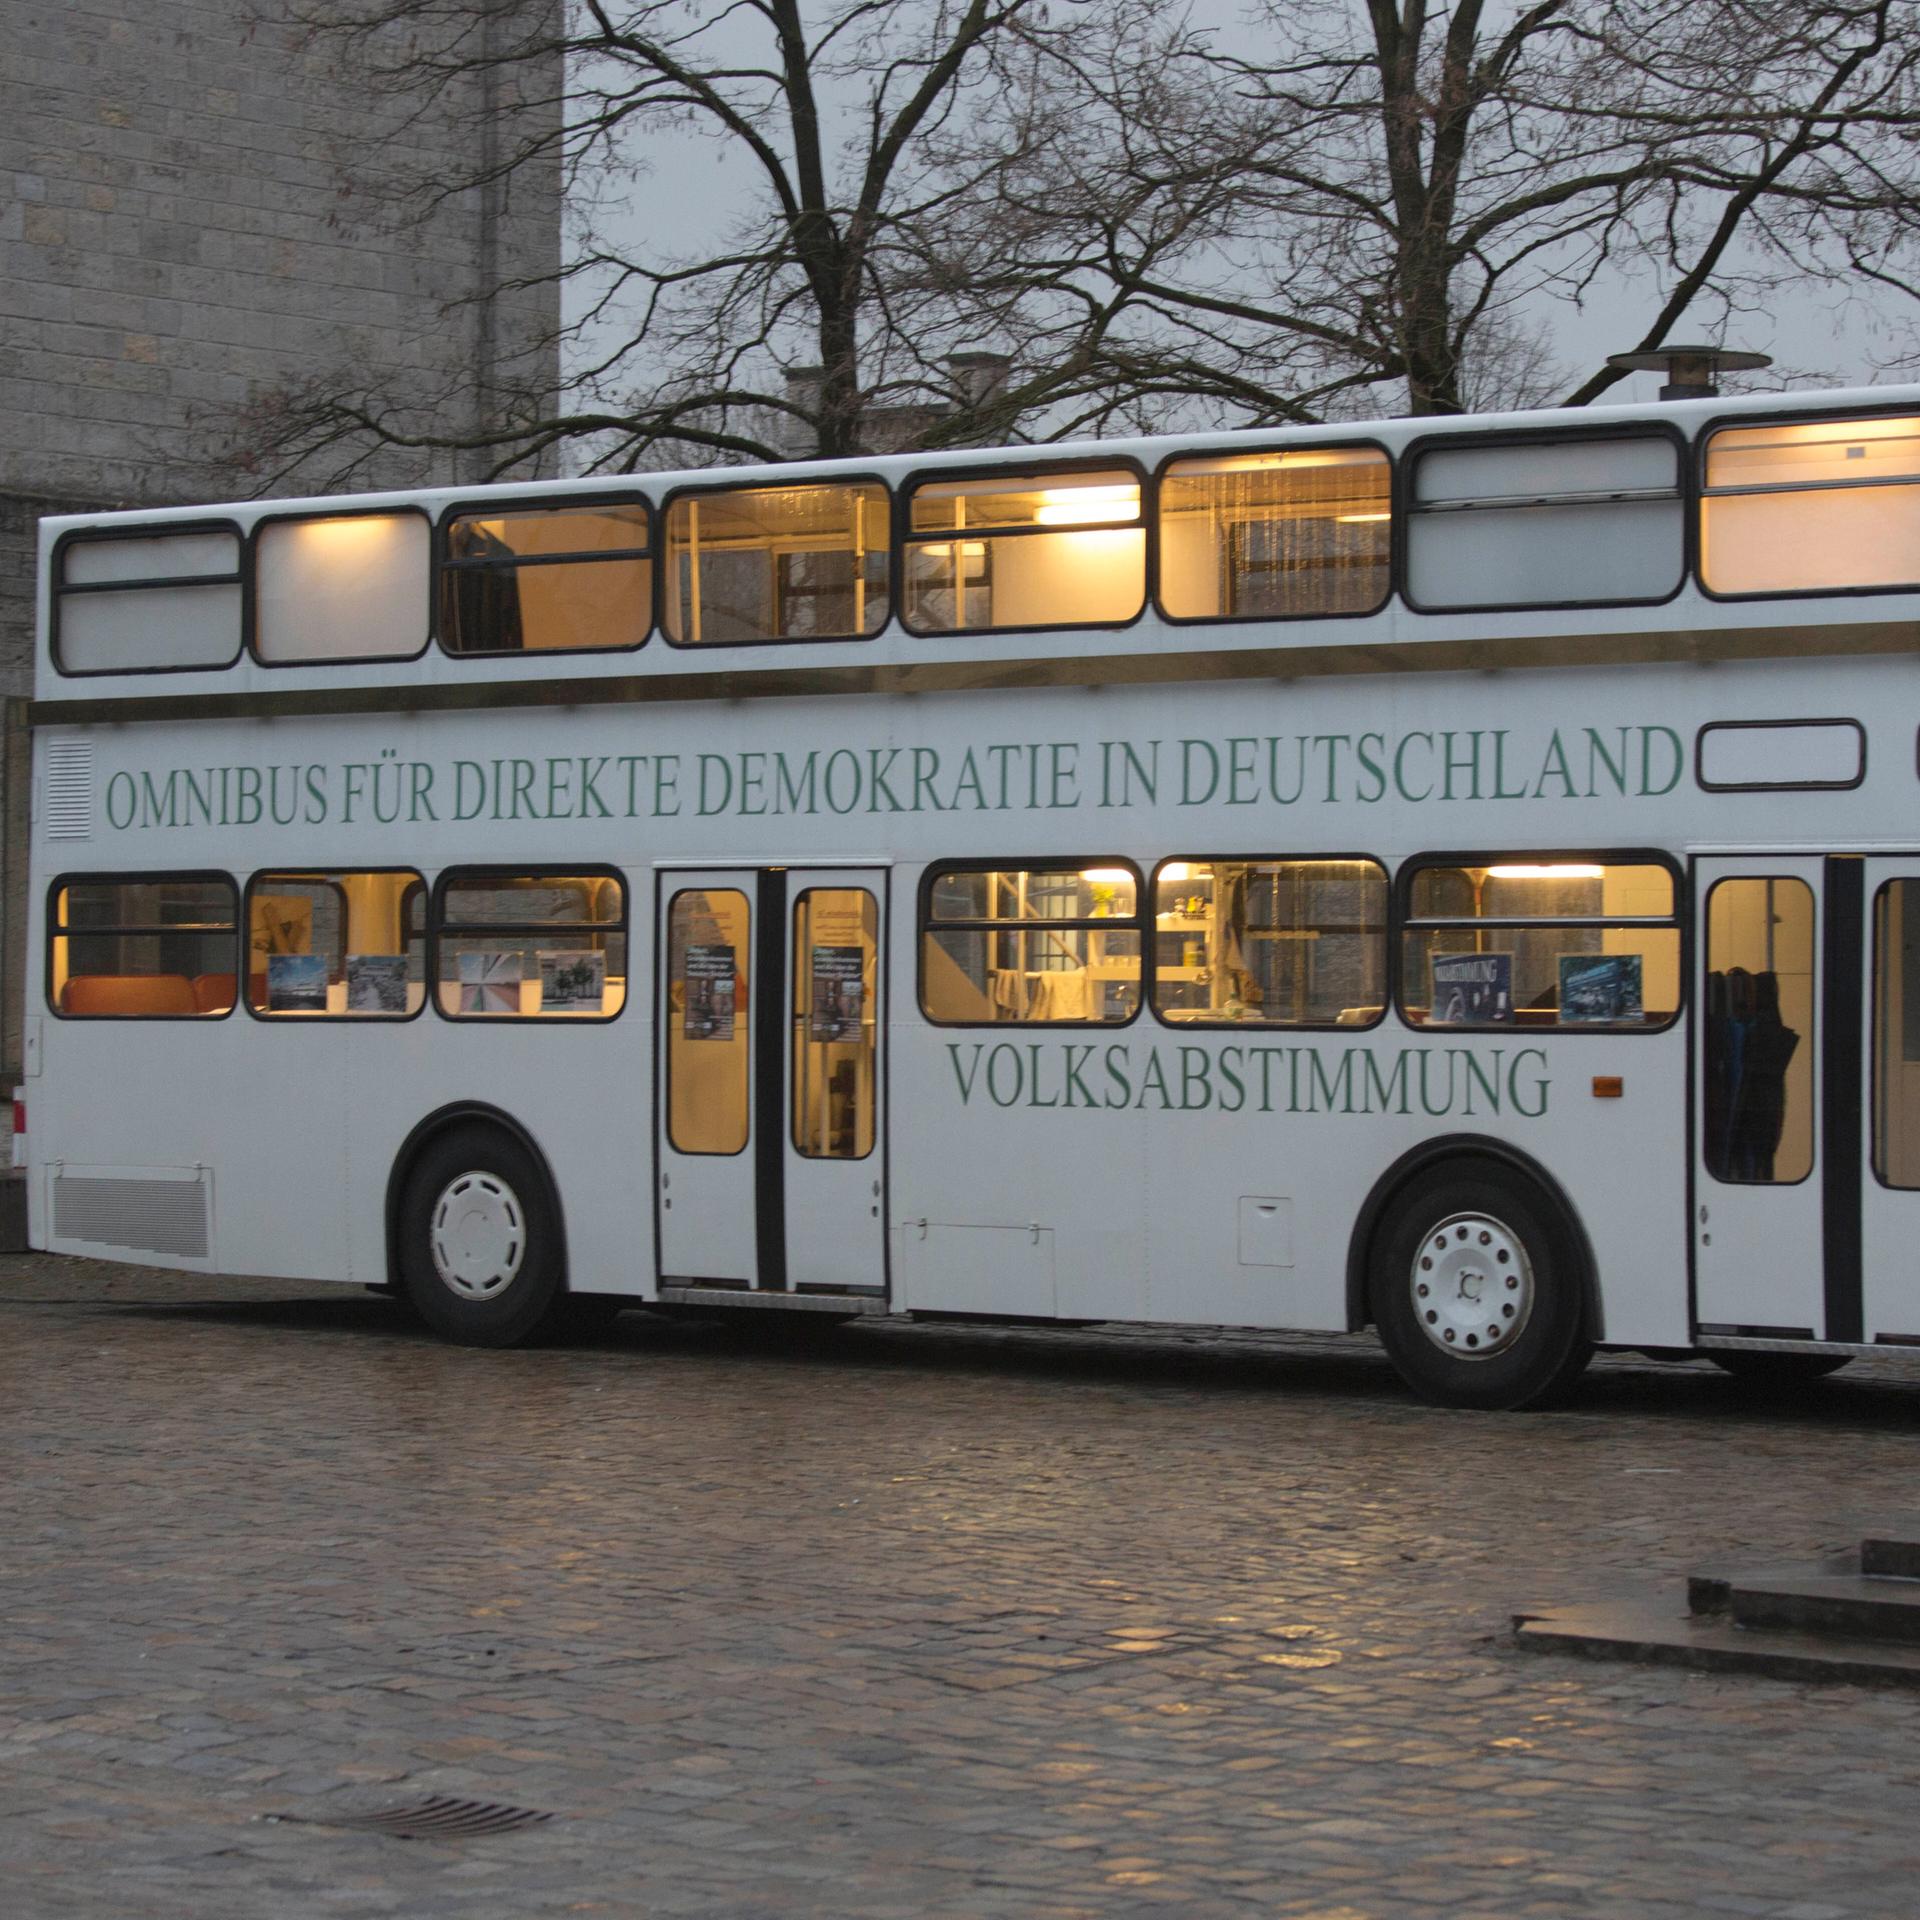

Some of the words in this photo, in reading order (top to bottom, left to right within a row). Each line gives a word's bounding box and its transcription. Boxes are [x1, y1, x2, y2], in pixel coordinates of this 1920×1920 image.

[106, 764, 328, 830] OMNIBUS
[341, 748, 440, 824] FÜR
[451, 755, 681, 821] DIREKTE
[694, 742, 1080, 816] DEMOKRATIE
[1097, 740, 1163, 808] IN
[1176, 725, 1685, 806] DEUTSCHLAND
[945, 1042, 1553, 1118] VOLKSABSTIMMUNG
